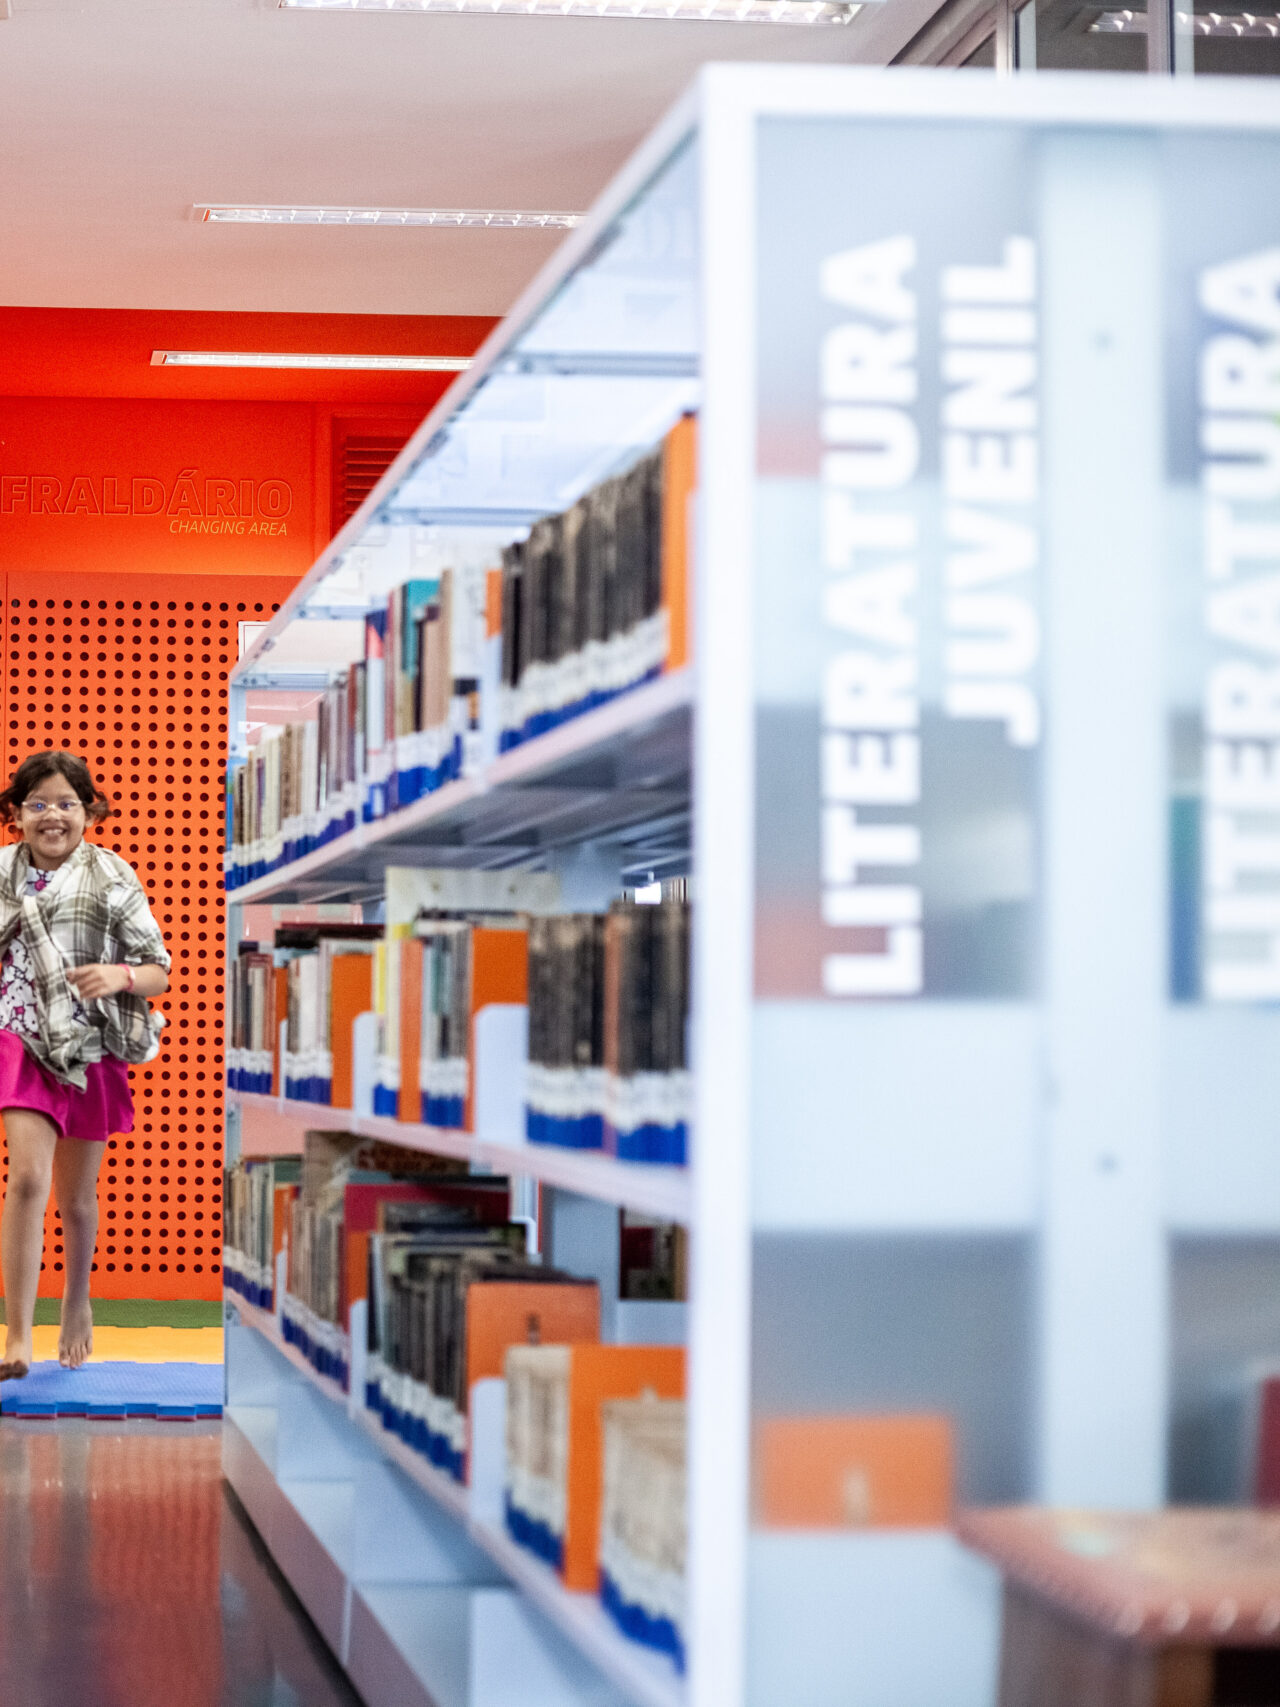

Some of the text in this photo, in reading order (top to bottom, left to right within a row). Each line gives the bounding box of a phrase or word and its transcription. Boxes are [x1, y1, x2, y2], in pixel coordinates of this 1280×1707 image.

[0, 469, 293, 519] FRALDÁRIO
[169, 519, 288, 536] CHANGING AREA
[820, 235, 923, 996] LITERATURA
[941, 235, 1040, 748] JUVENIL
[1201, 246, 1280, 1001] LITERATURA
